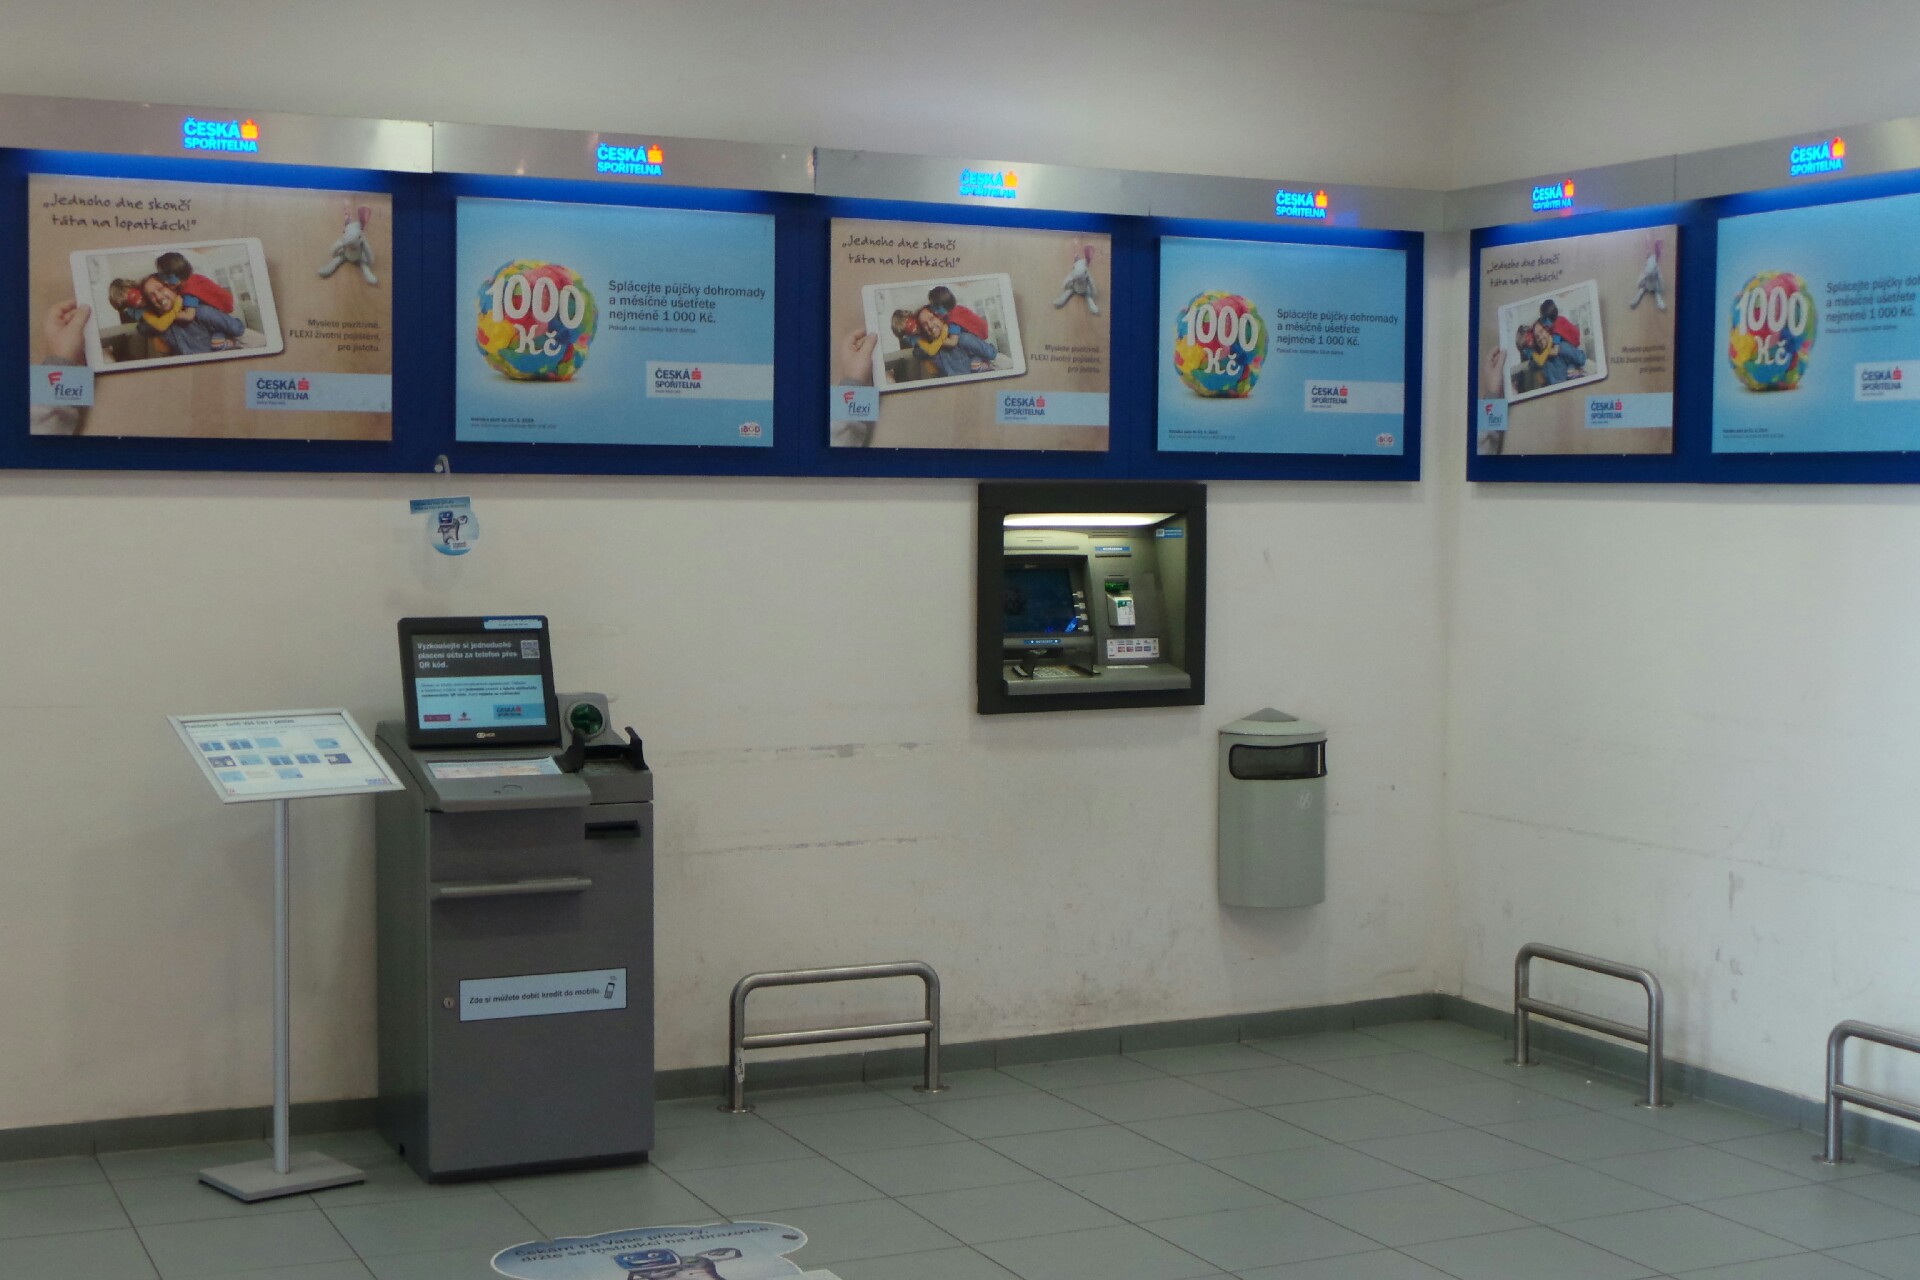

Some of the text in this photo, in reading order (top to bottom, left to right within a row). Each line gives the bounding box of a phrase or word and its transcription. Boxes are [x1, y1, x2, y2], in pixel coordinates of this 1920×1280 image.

[183, 117, 241, 139] ČESKÁ
[183, 136, 259, 153] SPOŘITELNA
[1791, 141, 1829, 163] ČESKÁ
[597, 143, 647, 163] ČESKÁ
[597, 160, 662, 176] SPOŘITELNA
[1791, 159, 1842, 176] SPOŘITELNA
[960, 168, 1003, 187] ČESKÁ
[1275, 189, 1315, 208] ČESKÁ
[1532, 183, 1562, 201] ČESKÁ
[115, 197, 143, 210] dne
[148, 198, 192, 212] skončí
[1275, 204, 1326, 219] SPOŘITELNA
[52, 214, 87, 227] táta
[92, 218, 111, 228] na
[898, 238, 919, 249] dne
[922, 238, 956, 251] skončí
[848, 253, 876, 264] táta
[879, 256, 894, 265] na
[608, 280, 766, 300] Splácejte půjčky dohromady
[485, 274, 585, 329] 1000
[608, 294, 716, 310] a měsíčně ušetřete
[608, 309, 717, 324] nejméně 1 000 Kč.
[1277, 308, 1318, 322] Splácejte
[1350, 312, 1398, 326] dohromady
[1736, 286, 1808, 336] 1000
[290, 329, 313, 339] FLEXI
[1182, 304, 1259, 352] 1000
[1325, 320, 1360, 334] ušetřete
[513, 324, 561, 356] Kč
[1277, 334, 1315, 346] nejméně
[1318, 336, 1324, 346] 1
[1326, 335, 1345, 347] 000
[337, 344, 351, 352] pro
[1754, 335, 1790, 365] Kč
[1203, 347, 1240, 376] Kč
[655, 368, 690, 380] ČESKÁ
[55, 384, 83, 397] flexi
[256, 378, 296, 391] ČESKÁ
[655, 380, 701, 389] SPOŘITELNA
[1311, 386, 1338, 396] ČESKÁ
[256, 390, 309, 401] SPOŘITELNA
[1004, 396, 1035, 407] ČESKÁ
[849, 402, 870, 414] flexi
[1004, 407, 1045, 416] SPOŘITELNA
[1591, 400, 1614, 411] ČESKÁ
[420, 661, 448, 670] QR kód.
[470, 996, 483, 1004] Zde
[493, 993, 520, 1003] můžete
[542, 989, 563, 999] kredit
[564, 989, 573, 997] do
[665, 1236, 686, 1245] na
